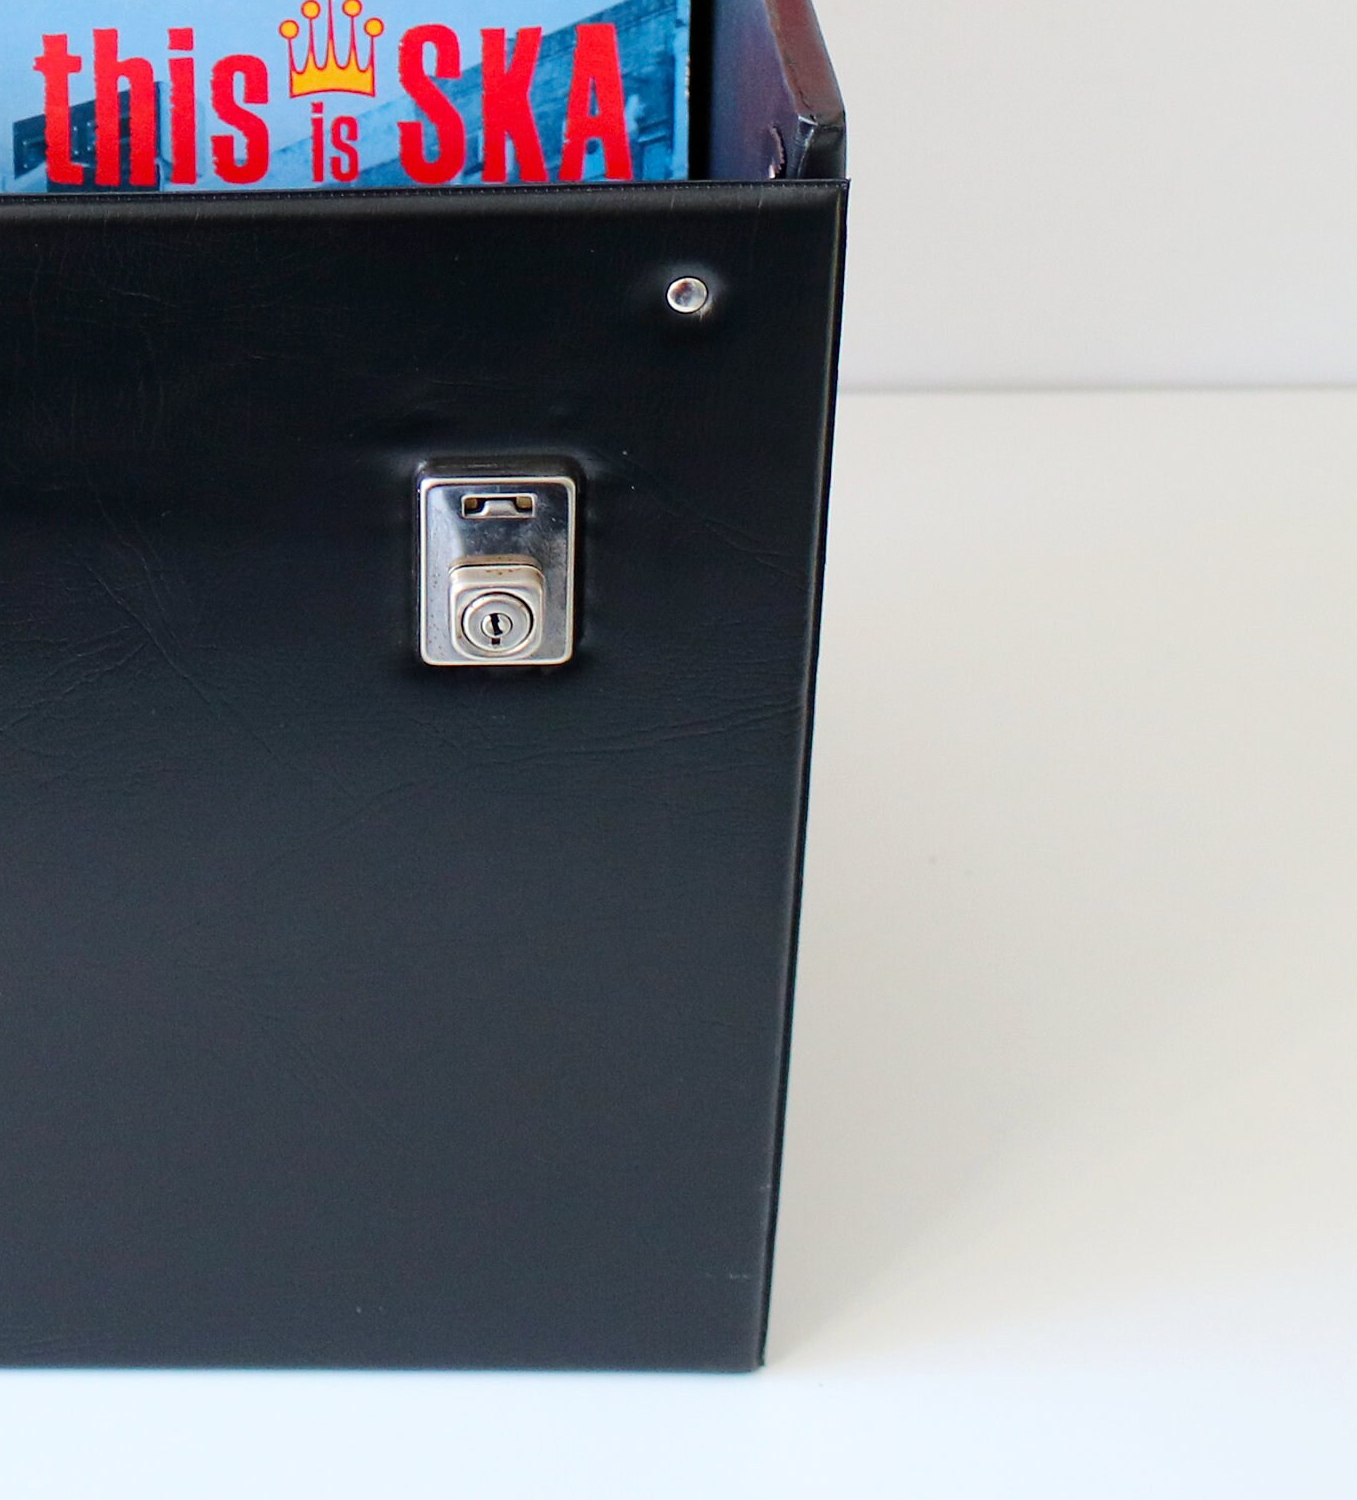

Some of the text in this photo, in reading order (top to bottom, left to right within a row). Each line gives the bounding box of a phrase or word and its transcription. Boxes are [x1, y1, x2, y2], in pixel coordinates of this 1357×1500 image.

[33, 23, 633, 187] this is SKA
